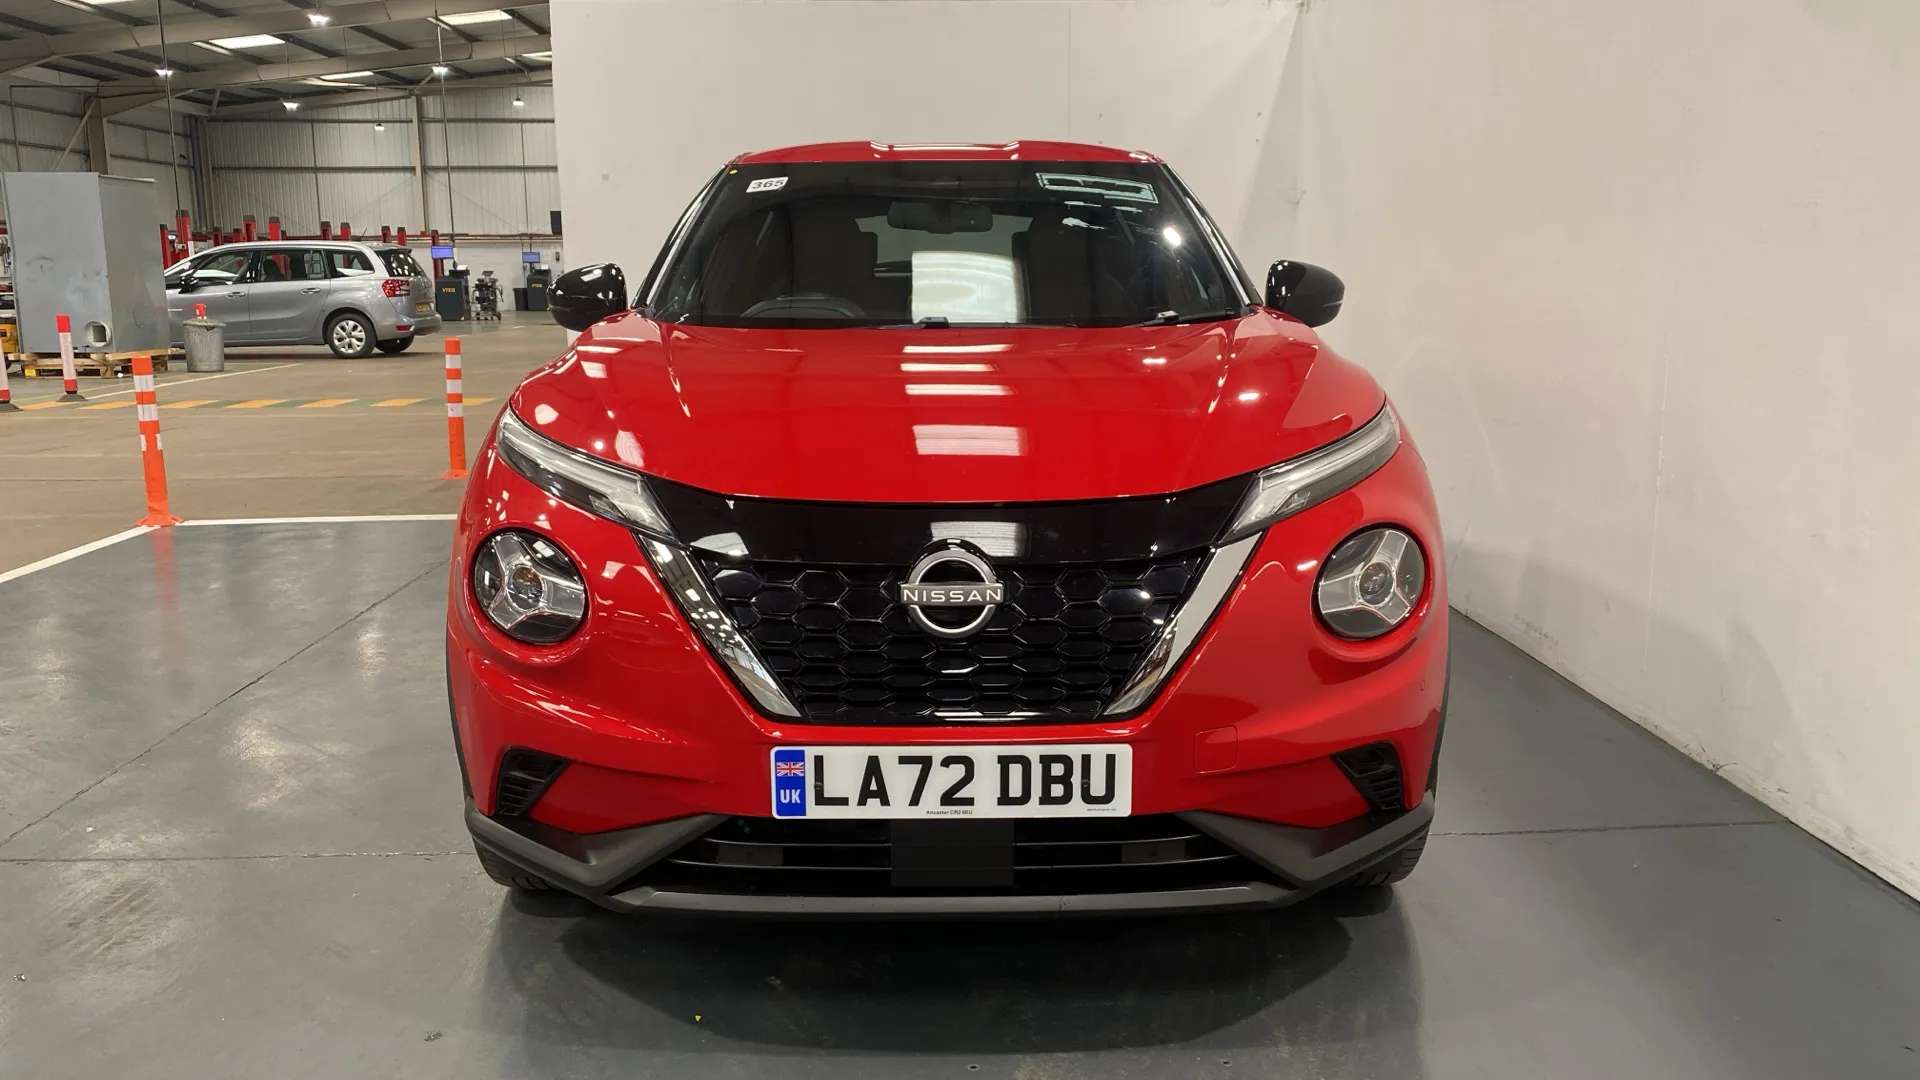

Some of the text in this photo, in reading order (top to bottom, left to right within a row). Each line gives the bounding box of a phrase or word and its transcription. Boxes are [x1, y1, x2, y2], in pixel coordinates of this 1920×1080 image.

[752, 180, 784, 190] 365
[904, 589, 1001, 603] NISSAN
[814, 753, 1116, 807] LA72 DBU
[780, 789, 801, 804] UK
